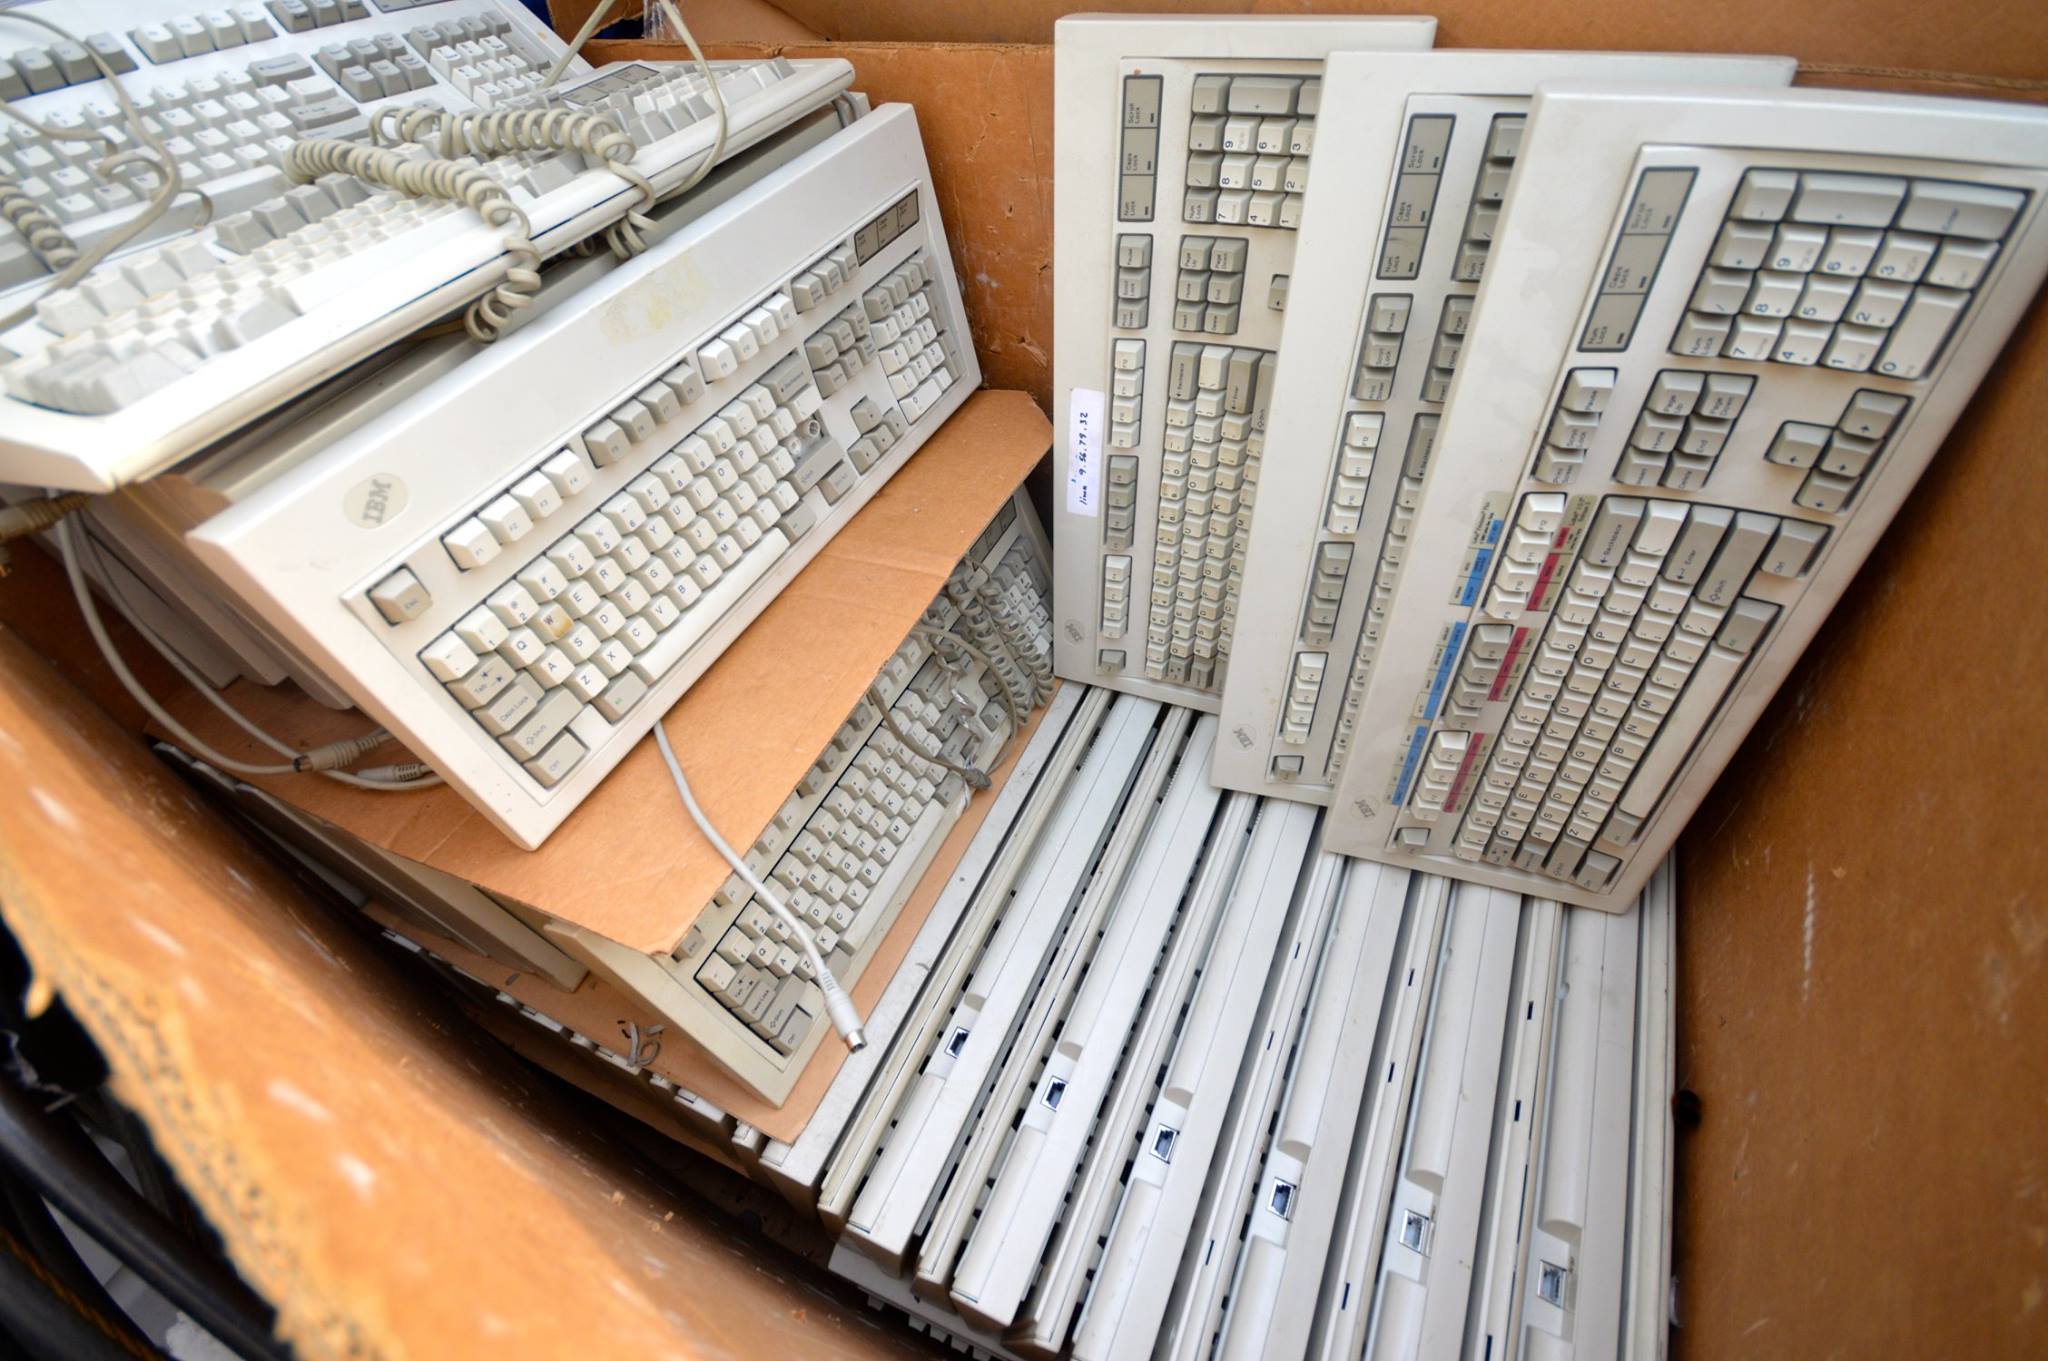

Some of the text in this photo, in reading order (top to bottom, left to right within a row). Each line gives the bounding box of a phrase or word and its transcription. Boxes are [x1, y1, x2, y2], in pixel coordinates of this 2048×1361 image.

[1777, 258, 1791, 267] 9
[1827, 262, 1841, 271] 6
[1881, 266, 1895, 275] 3
[1755, 304, 1769, 312] 8
[1803, 307, 1816, 316] 5
[1856, 312, 1871, 322] 2
[1781, 352, 1794, 360] 4
[1883, 362, 1896, 372] 0
[738, 450, 745, 459] P
[718, 468, 725, 476] O
[362, 479, 392, 524] IBM
[672, 506, 681, 515] U
[717, 509, 725, 519] K
[629, 519, 636, 527] 6
[649, 526, 657, 534] Y
[625, 546, 633, 556] T
[720, 543, 729, 553] M
[673, 548, 682, 558] H
[700, 563, 708, 573] N
[600, 569, 608, 579] R
[650, 569, 658, 578] G
[549, 588, 558, 596] 3
[678, 584, 686, 594] B
[572, 592, 582, 602] E
[625, 591, 632, 601] F
[655, 606, 663, 615] V
[520, 612, 529, 621] 2
[543, 615, 553, 625] W
[600, 614, 609, 624] D
[632, 628, 640, 637] C
[516, 640, 527, 650] Q
[574, 637, 583, 647] S
[607, 651, 616, 661] X
[548, 661, 557, 672] A
[580, 675, 591, 686] Z
[1641, 700, 1651, 708] M
[1628, 724, 1637, 732] N
[1581, 809, 1589, 817] X
[1570, 828, 1578, 836] Z
